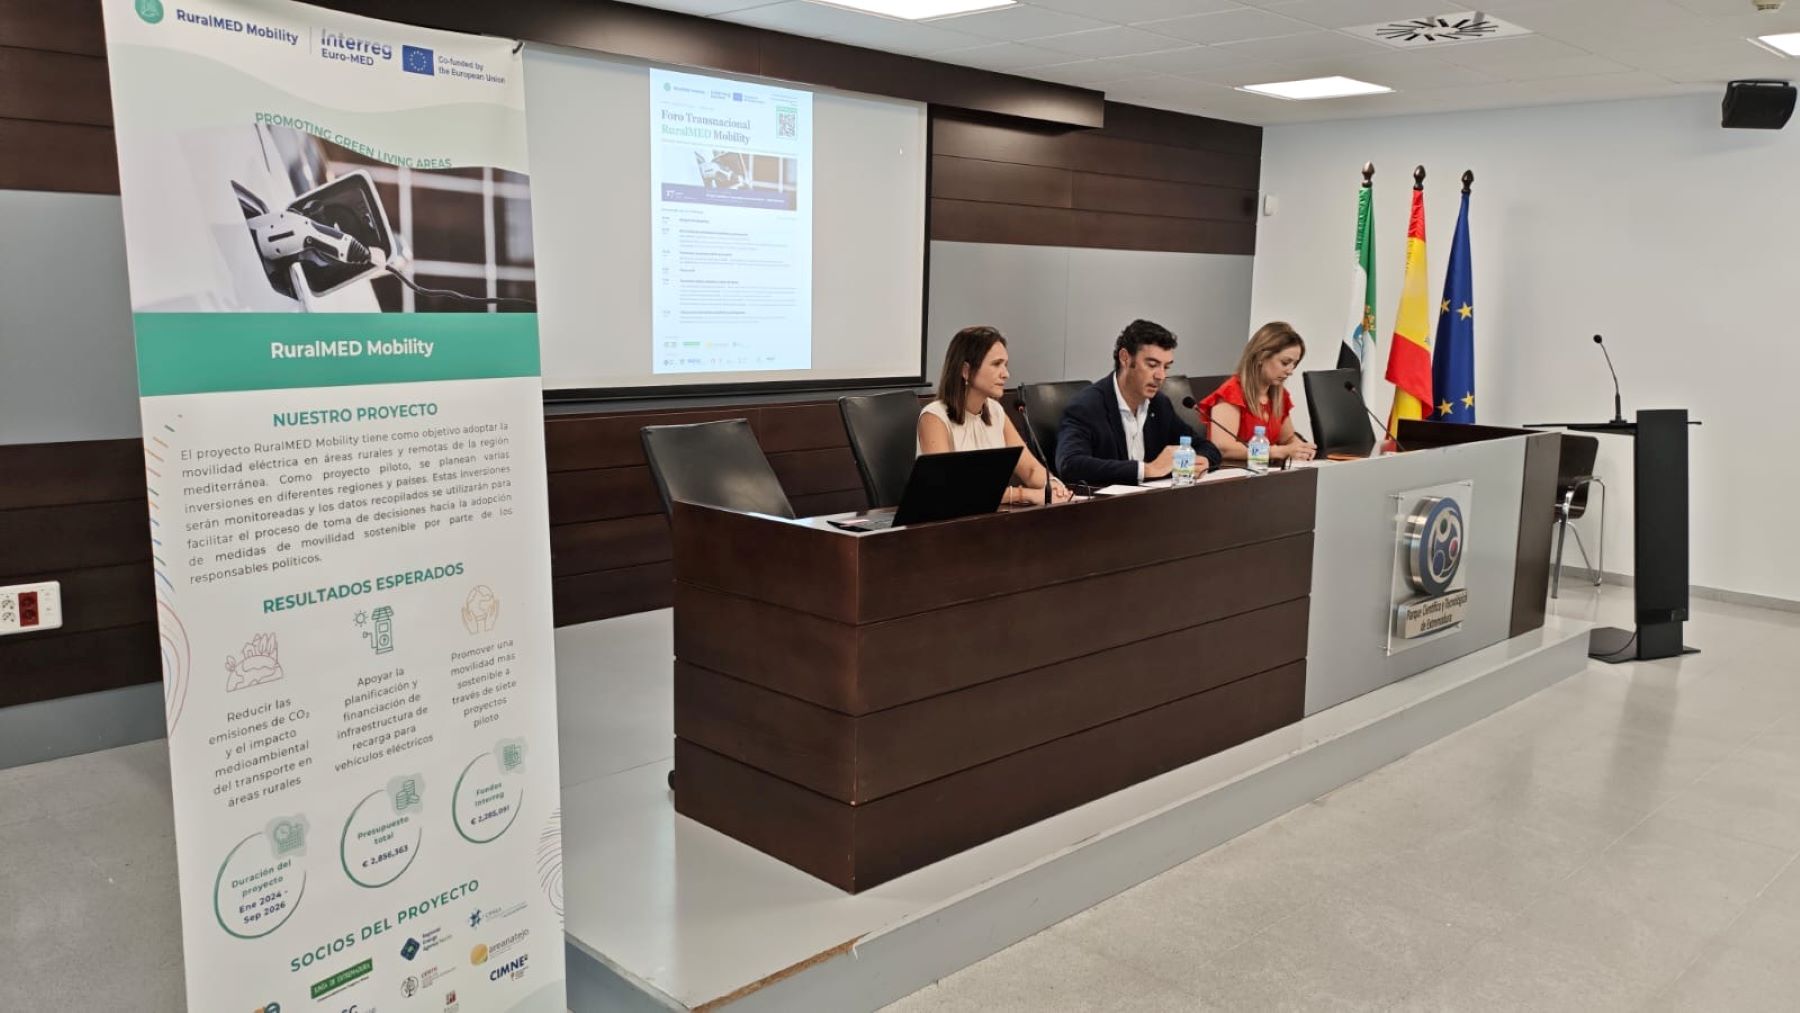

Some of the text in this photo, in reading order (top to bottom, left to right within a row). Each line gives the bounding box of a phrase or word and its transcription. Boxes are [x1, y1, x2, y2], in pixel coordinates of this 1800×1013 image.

[176, 9, 299, 46] RuralMED Mobility
[321, 29, 392, 60] Interreg
[321, 47, 374, 66] Euro-MED
[438, 55, 484, 71] Co-funded by
[438, 66, 506, 84] the European Union
[661, 109, 751, 130] Foro Transnacional
[255, 112, 453, 169] PROMOTING GREEN LIVING AREAS
[661, 124, 749, 146] RuralMED Mobility
[270, 337, 434, 360] RuralMED Mobility
[273, 403, 438, 428] NUESTRO PROYECTO
[181, 422, 508, 461] El proyecto RuralMED Mobility tiene como objetivo adoptar la
[182, 436, 509, 478] movilidad eléctrica en áreas rurales y remotas de la región
[279, 473, 313, 485] Como
[323, 466, 370, 480] proyecto
[379, 462, 412, 474] piloto,
[419, 460, 431, 468] se
[439, 454, 476, 467] planean
[484, 452, 510, 461] varias
[185, 497, 254, 514] inversiones
[258, 494, 273, 504] en
[277, 486, 334, 502] diferentes
[337, 481, 383, 495] regiones
[387, 480, 392, 489] y
[432, 472, 457, 482] Estas
[461, 466, 511, 479] inversiones
[186, 481, 512, 532] serán monitoreadas y los datos recopilados se utilizarán para
[187, 493, 512, 550] facilitar el proceso de toma de decisiones hacia la adopción
[188, 507, 513, 567] de medidas de movilidad sostenible por parte de los
[190, 554, 322, 585] responsables políticos.
[263, 562, 464, 614] RESULTADOS ESPERADOS
[451, 639, 514, 663] Promover una
[357, 667, 405, 687] Apoyar la
[451, 657, 495, 676] movilidad
[457, 668, 511, 689] sostenible a
[344, 680, 418, 709] planificación y
[482, 686, 494, 696] de
[496, 680, 517, 692] siete
[227, 698, 292, 722] Reducir las
[343, 693, 421, 722] financiación de
[463, 697, 508, 718] proyectos
[473, 713, 500, 728] piloto
[208, 723, 268, 745] emisiones
[271, 716, 286, 727] de
[337, 706, 428, 740] infraestructura de
[225, 729, 297, 760] y el impacto
[352, 725, 416, 751] recarga para
[215, 740, 309, 778] medioambiental
[334, 734, 434, 772] vehículos eléctricos
[213, 756, 313, 796] del transporte en
[262, 776, 302, 796] rurales
[358, 816, 409, 840] Presupuesto
[374, 832, 394, 845] total
[231, 859, 292, 889] Duración del
[362, 860, 369, 868] €
[242, 875, 284, 898] proyecto
[239, 901, 257, 914] Ene
[259, 892, 282, 906] 2024
[243, 901, 286, 924] Sep 2026
[290, 933, 355, 973] SOCIOS
[361, 917, 392, 941] DEL
[397, 879, 479, 925] PROYECTO
